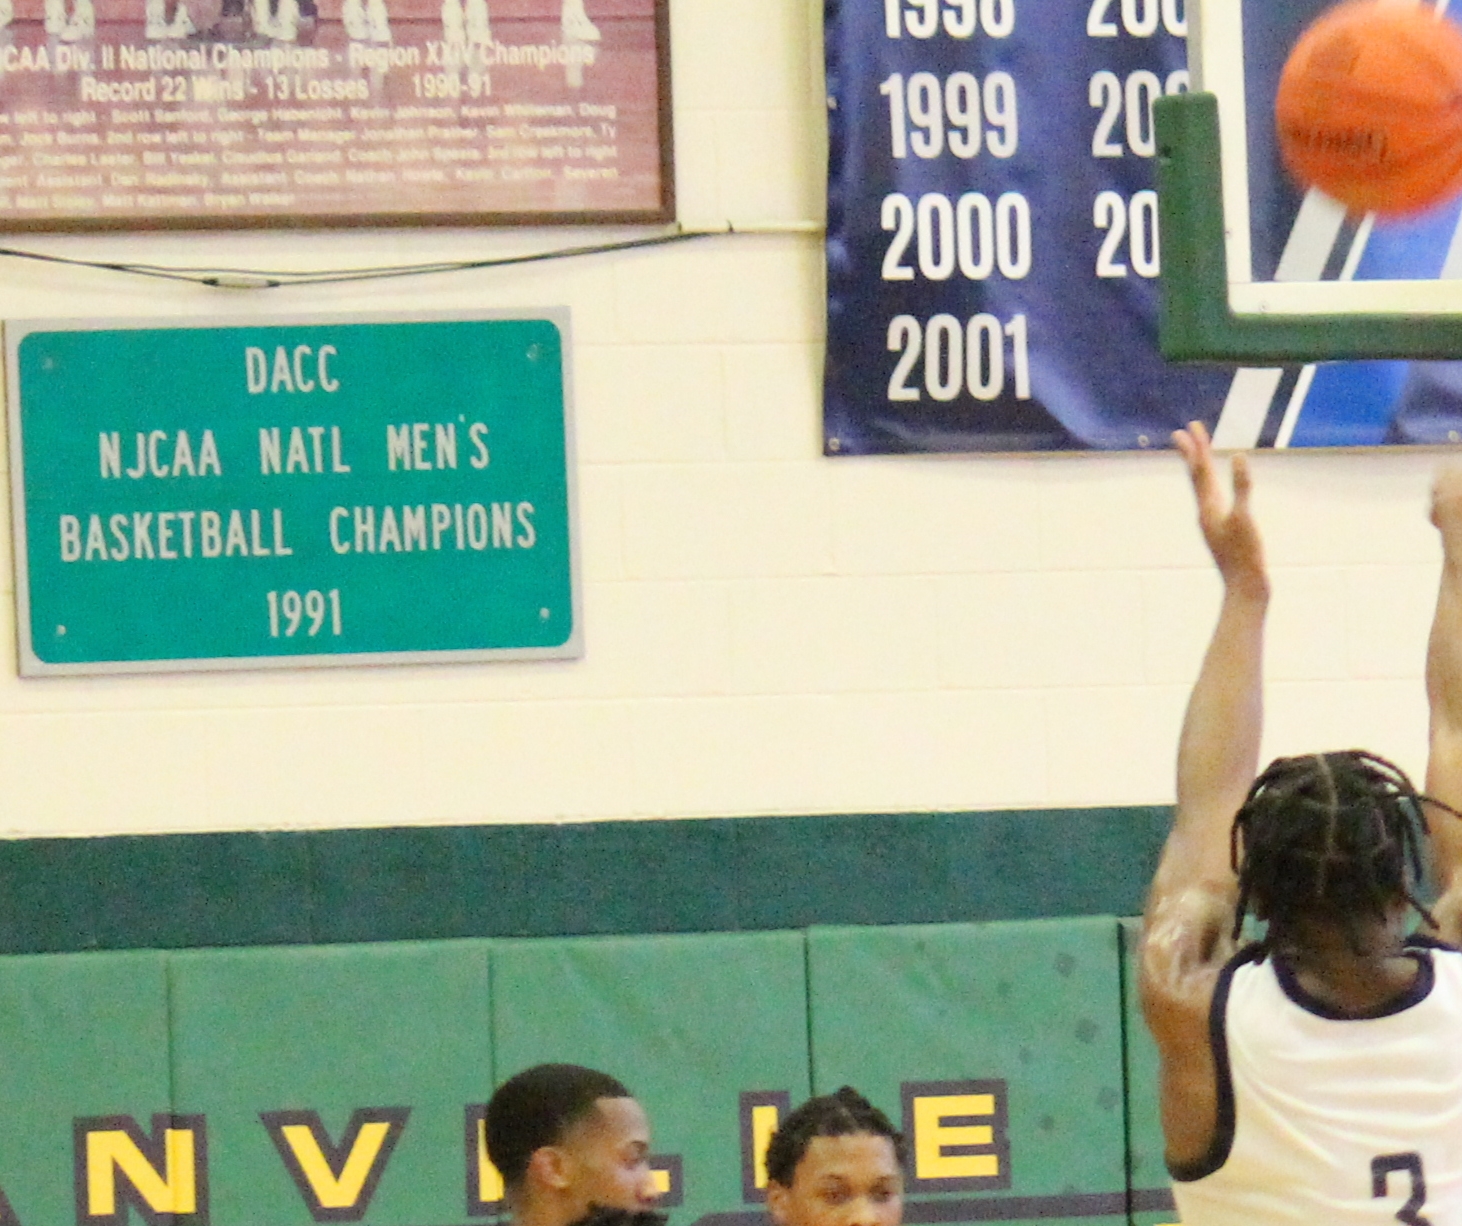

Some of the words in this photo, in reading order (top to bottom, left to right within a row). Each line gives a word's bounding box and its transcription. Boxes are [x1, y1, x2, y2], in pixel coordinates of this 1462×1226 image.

[55, 45, 95, 71] Div.
[102, 45, 114, 70] II
[120, 43, 207, 71] National
[211, 42, 330, 73] Champions
[349, 42, 422, 72] Region
[481, 39, 596, 70] Champions
[81, 76, 156, 102] Record
[161, 75, 187, 101] 22
[192, 74, 245, 101] Wins
[265, 75, 289, 100] 13
[295, 75, 370, 100] Losses
[880, 70, 1019, 158] 1999
[880, 191, 1033, 281] 2000
[245, 345, 340, 395] DACC
[886, 312, 1033, 401] 2001
[98, 429, 222, 480] NJCAA
[259, 425, 351, 476] NATL
[386, 413, 491, 472] MEN'S
[59, 508, 293, 563] BASKETBALL
[328, 501, 537, 555] CHAMPIONS
[266, 588, 342, 639] 1991
